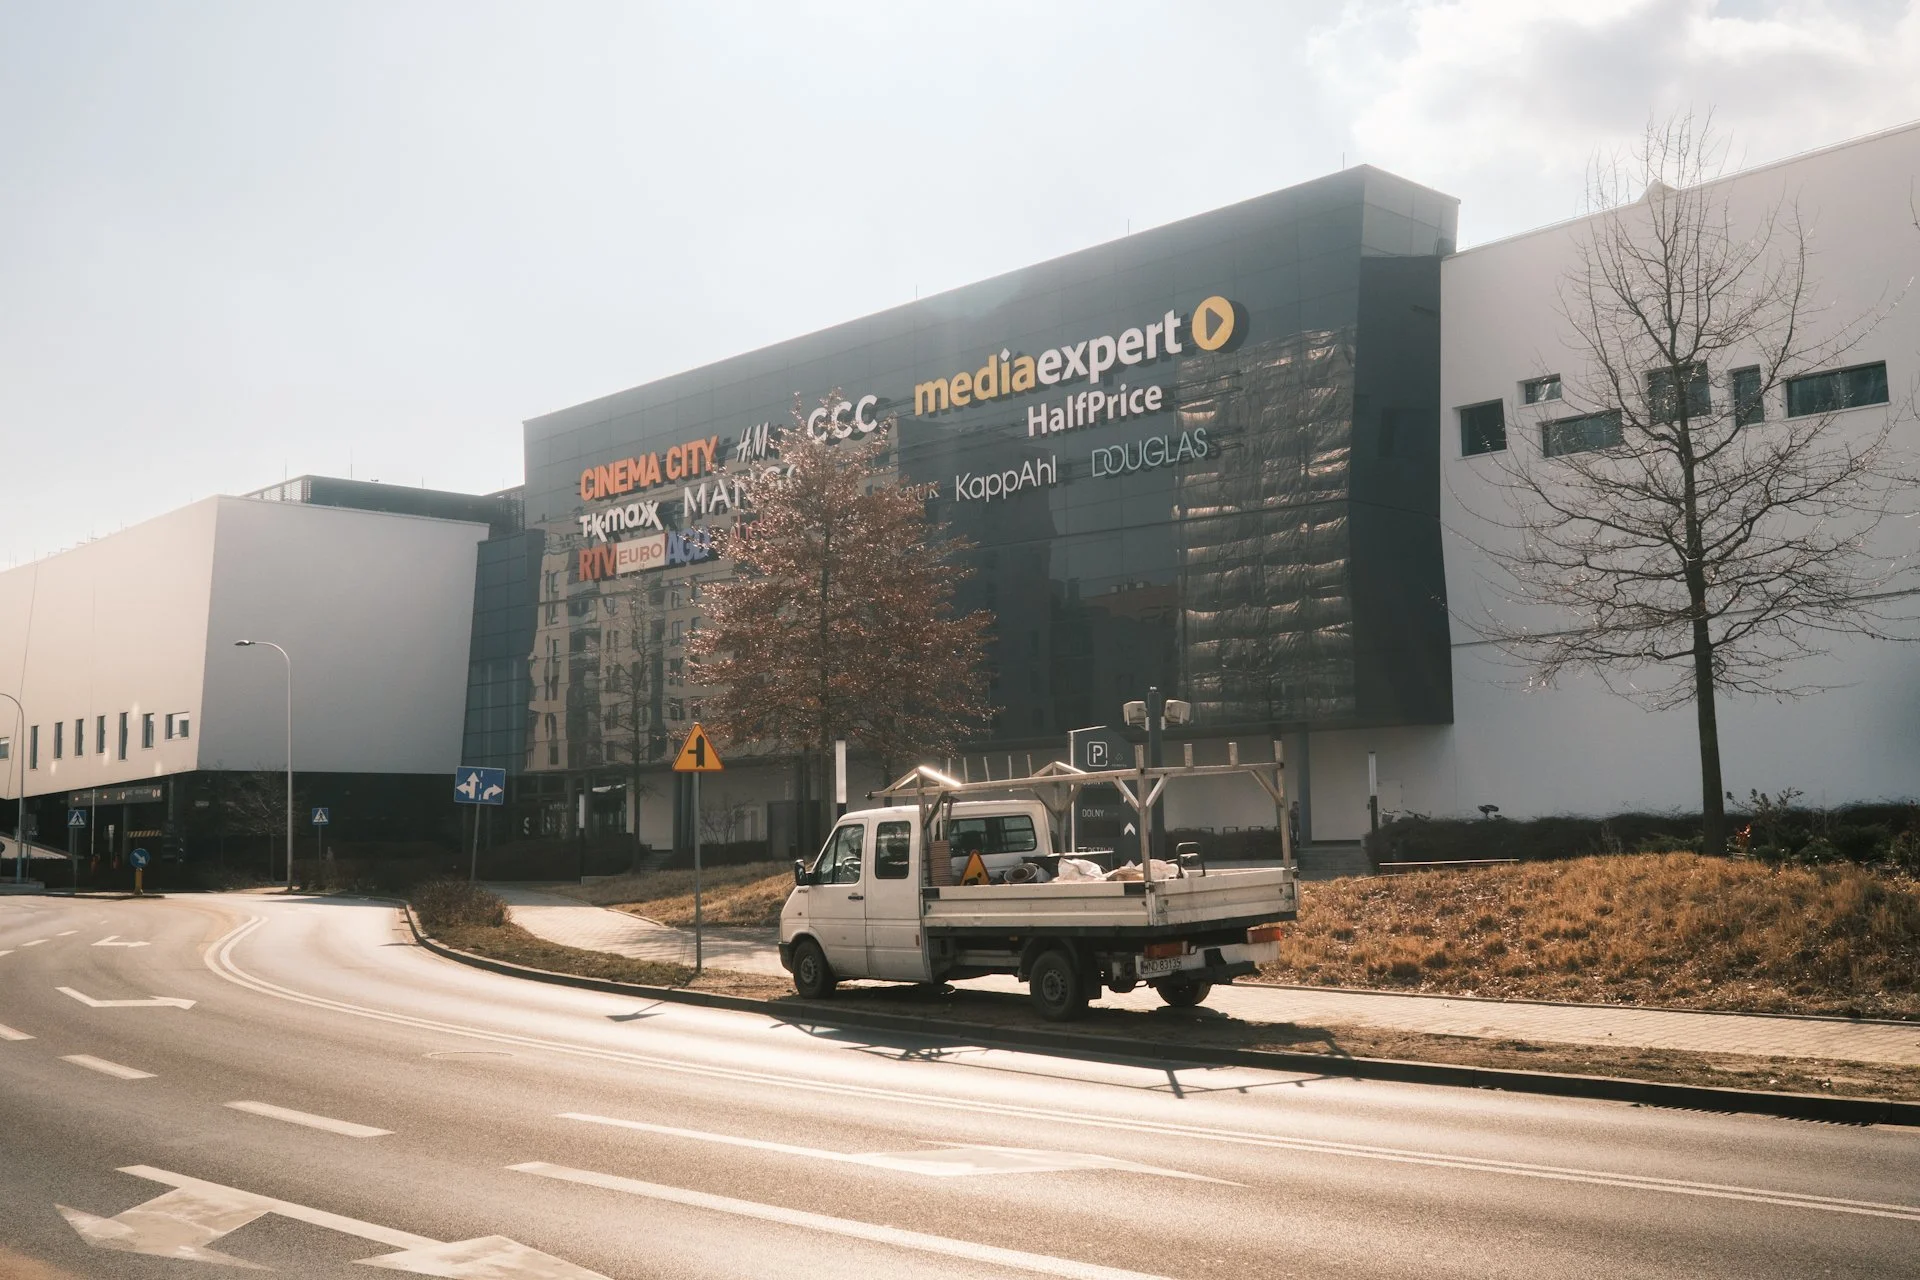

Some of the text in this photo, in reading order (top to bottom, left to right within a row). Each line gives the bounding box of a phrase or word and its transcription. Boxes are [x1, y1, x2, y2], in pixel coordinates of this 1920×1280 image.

[914, 309, 1182, 416] mediaexpert
[807, 394, 878, 443] CCC
[1028, 384, 1163, 437] HalfPrice
[580, 435, 719, 501] CINEMA CITY
[1092, 427, 1208, 478] DOUGLAS
[955, 455, 1057, 502] KappAhl
[579, 543, 618, 581] RTV
[619, 543, 663, 565] EURO
[1082, 808, 1105, 818] DOLNY
